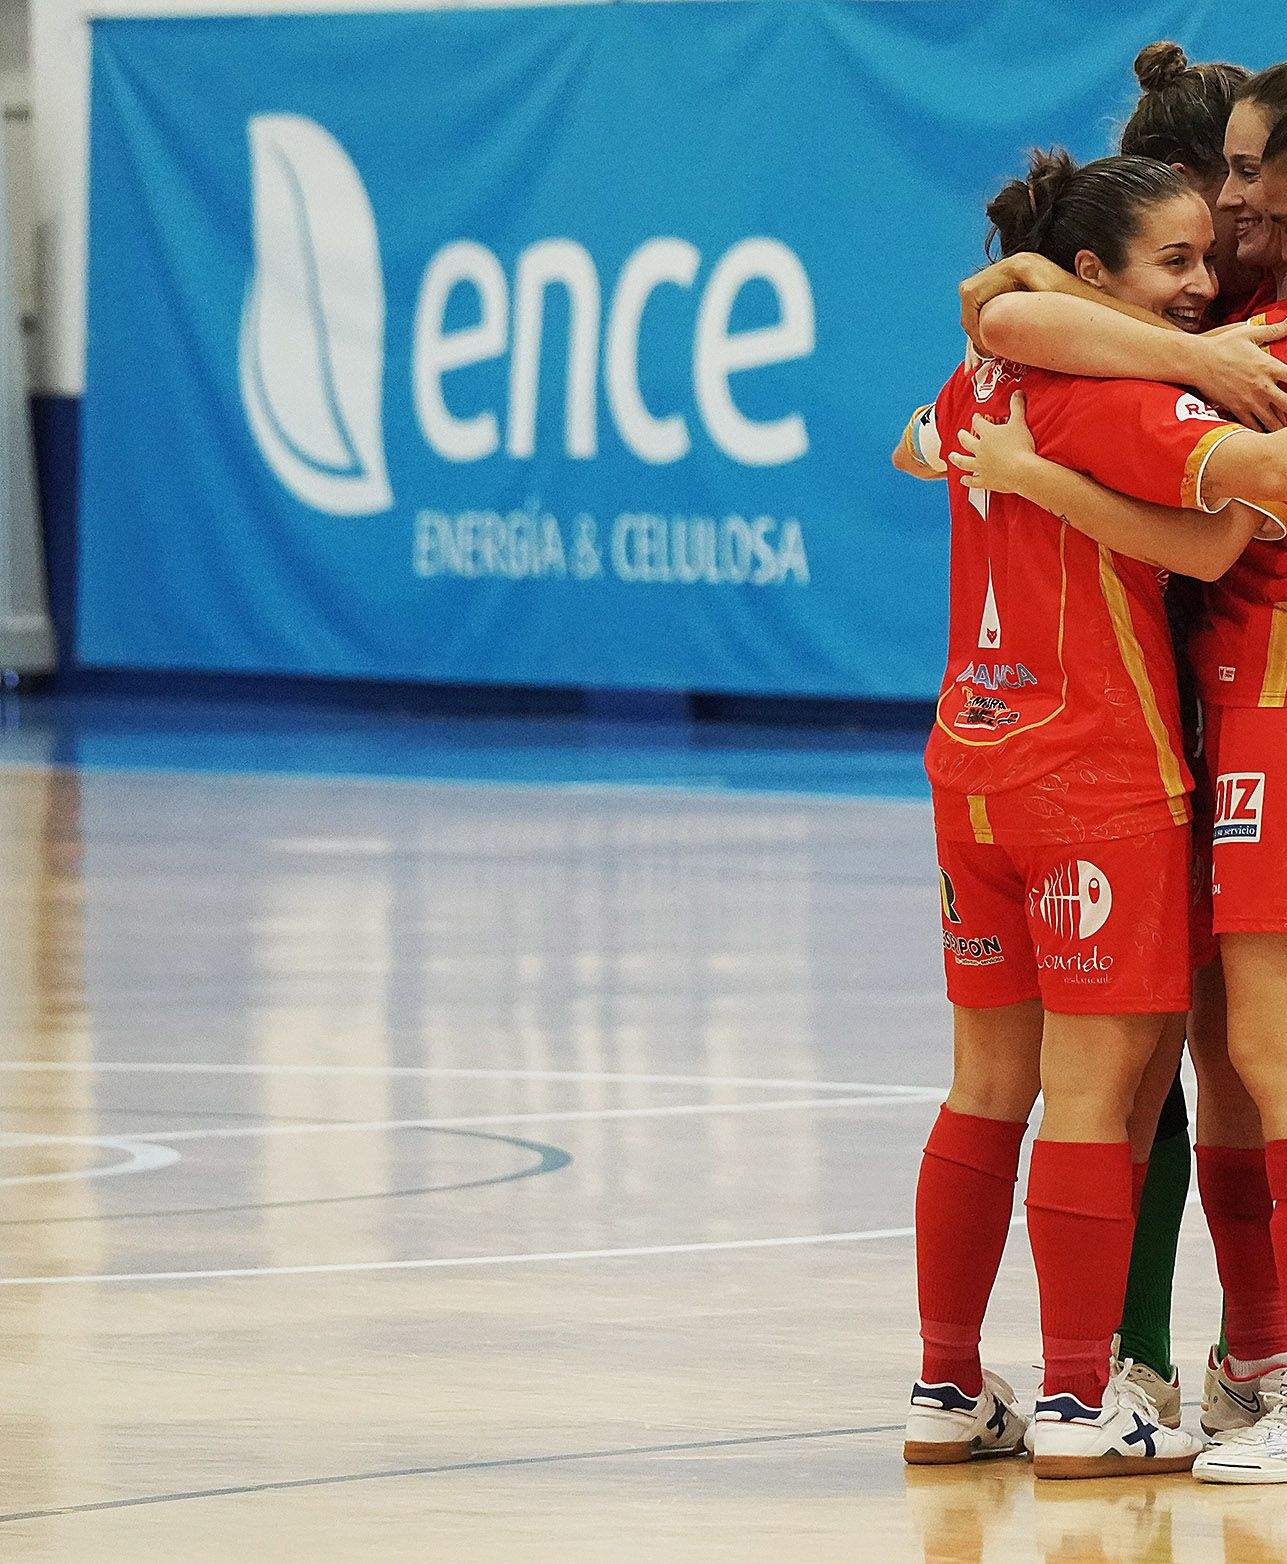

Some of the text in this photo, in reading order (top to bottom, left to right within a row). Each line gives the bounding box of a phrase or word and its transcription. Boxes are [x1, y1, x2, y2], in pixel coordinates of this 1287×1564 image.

[412, 236, 817, 467] ence
[414, 494, 811, 586] ENERGÍA & CELULOSA
